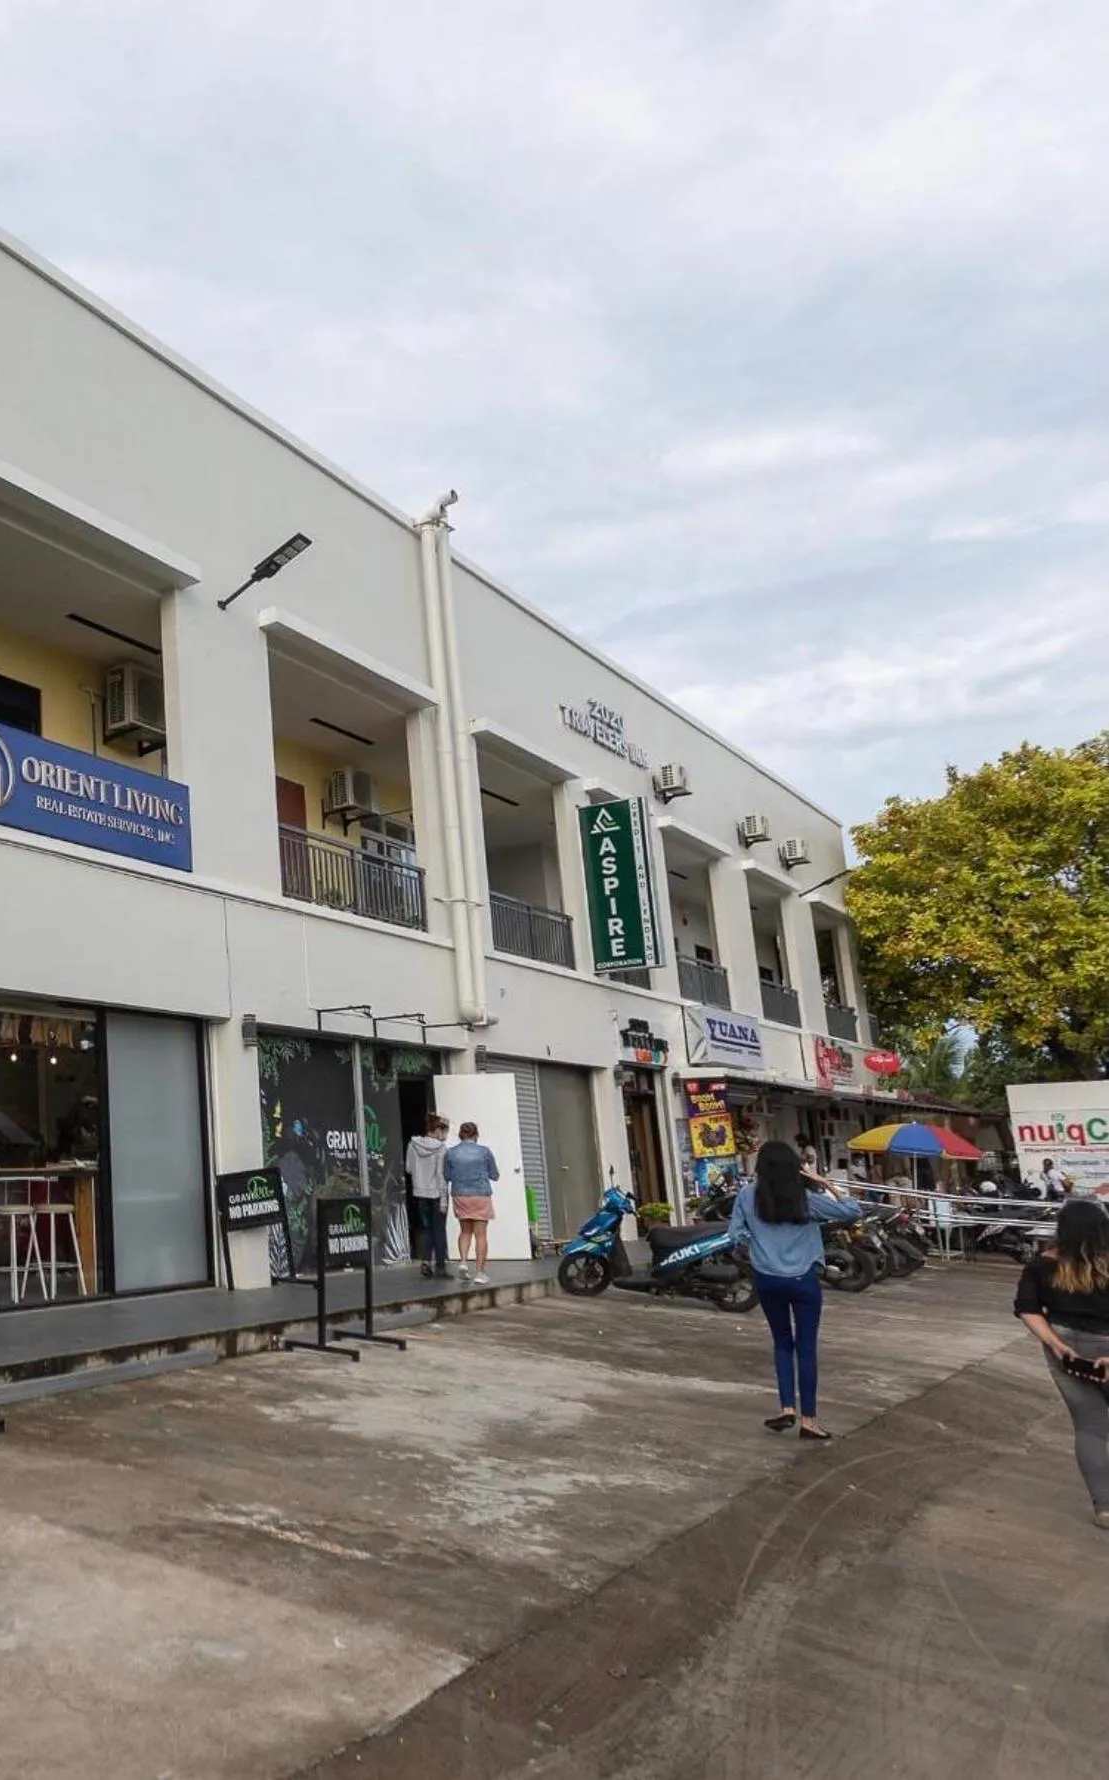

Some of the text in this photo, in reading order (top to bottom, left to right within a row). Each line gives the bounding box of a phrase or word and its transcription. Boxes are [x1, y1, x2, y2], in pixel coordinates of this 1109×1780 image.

[21, 756, 184, 825] ORIENT LIVING
[36, 795, 68, 815] REAL
[67, 804, 107, 826] ESTATE
[598, 837, 626, 957] ASPIRE
[706, 1017, 759, 1043] YUANA
[228, 1199, 280, 1219] NO PARKING
